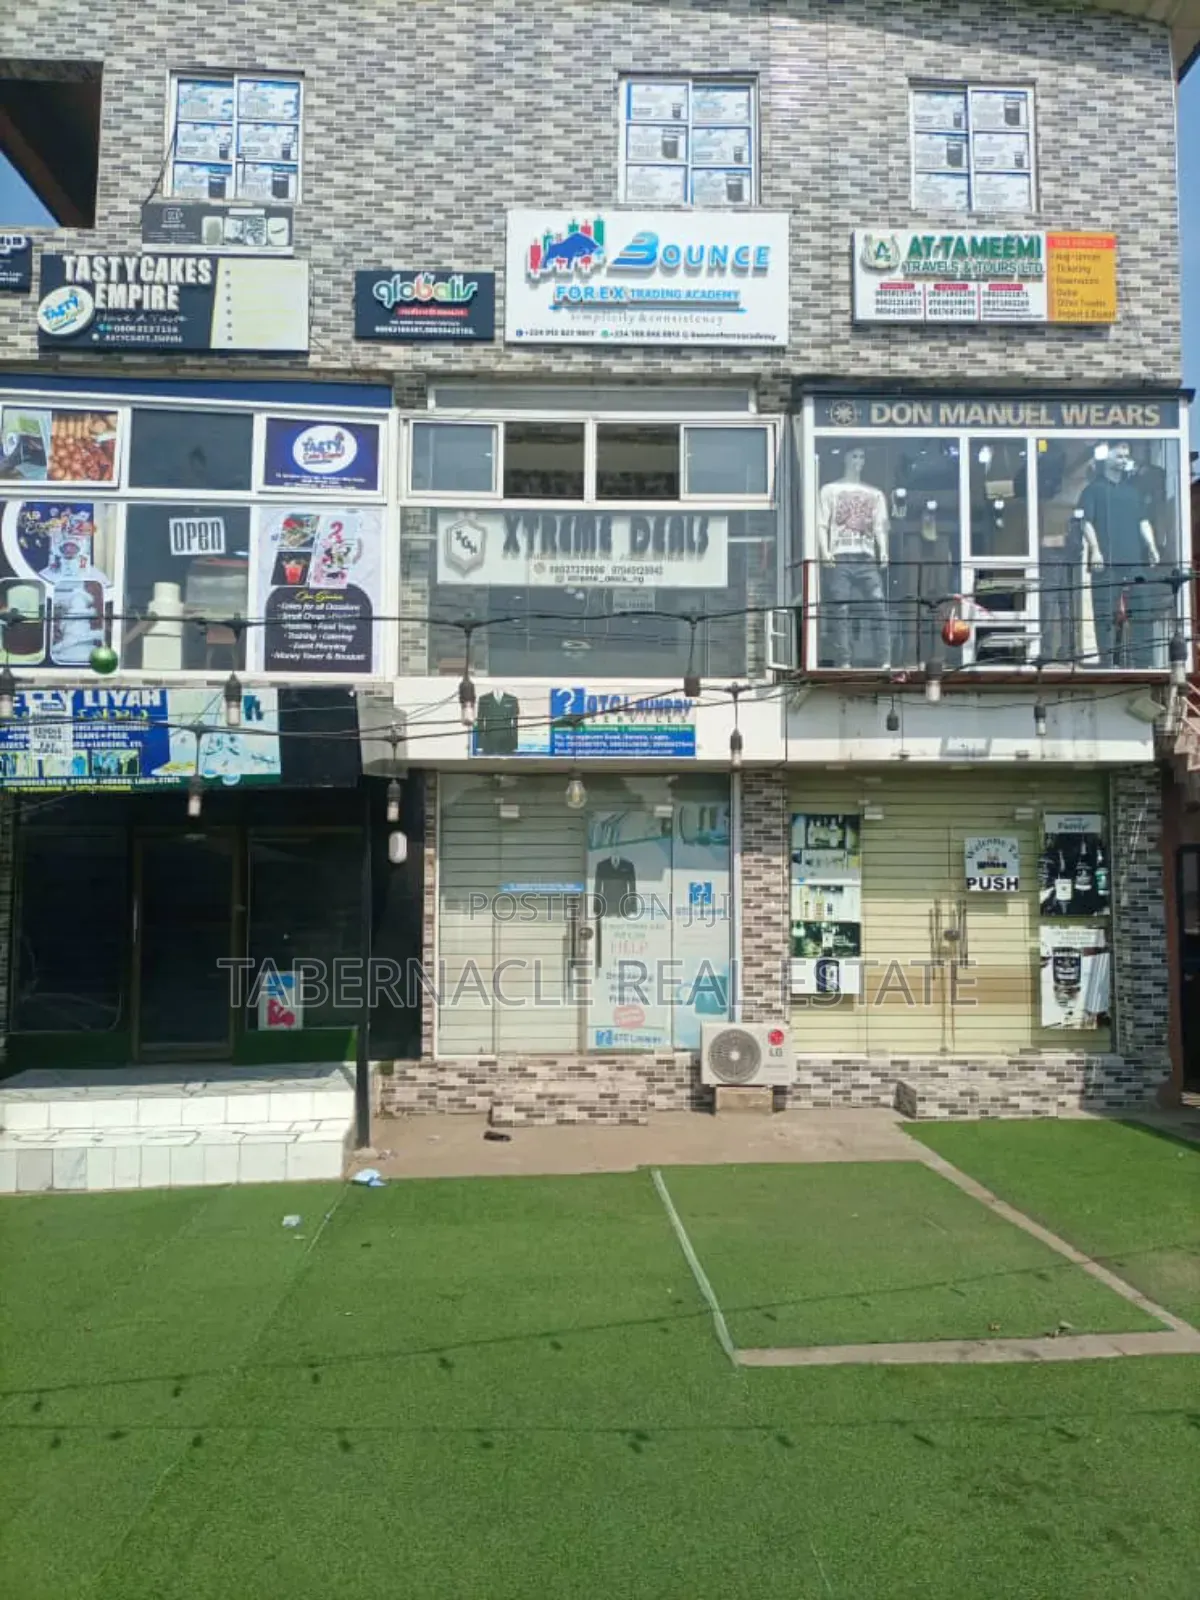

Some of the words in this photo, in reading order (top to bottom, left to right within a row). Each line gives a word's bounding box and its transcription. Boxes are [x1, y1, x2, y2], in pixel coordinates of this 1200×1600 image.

[611, 230, 771, 268] BOUNCE
[906, 234, 1042, 259] AT-TAMEEMI
[62, 255, 212, 284] TASTYCAKES
[903, 261, 960, 274] TRAVELS
[963, 261, 973, 274] &
[977, 261, 1019, 275] TOURS
[94, 283, 180, 311] EMPIRE
[555, 285, 625, 301] FOREX
[631, 289, 682, 301] TRADING
[684, 290, 741, 301] ACADEMY
[870, 403, 933, 425] DON
[939, 403, 1056, 426] MANUEL
[1061, 403, 1161, 426] WEARS
[966, 876, 1020, 891] PUSH
